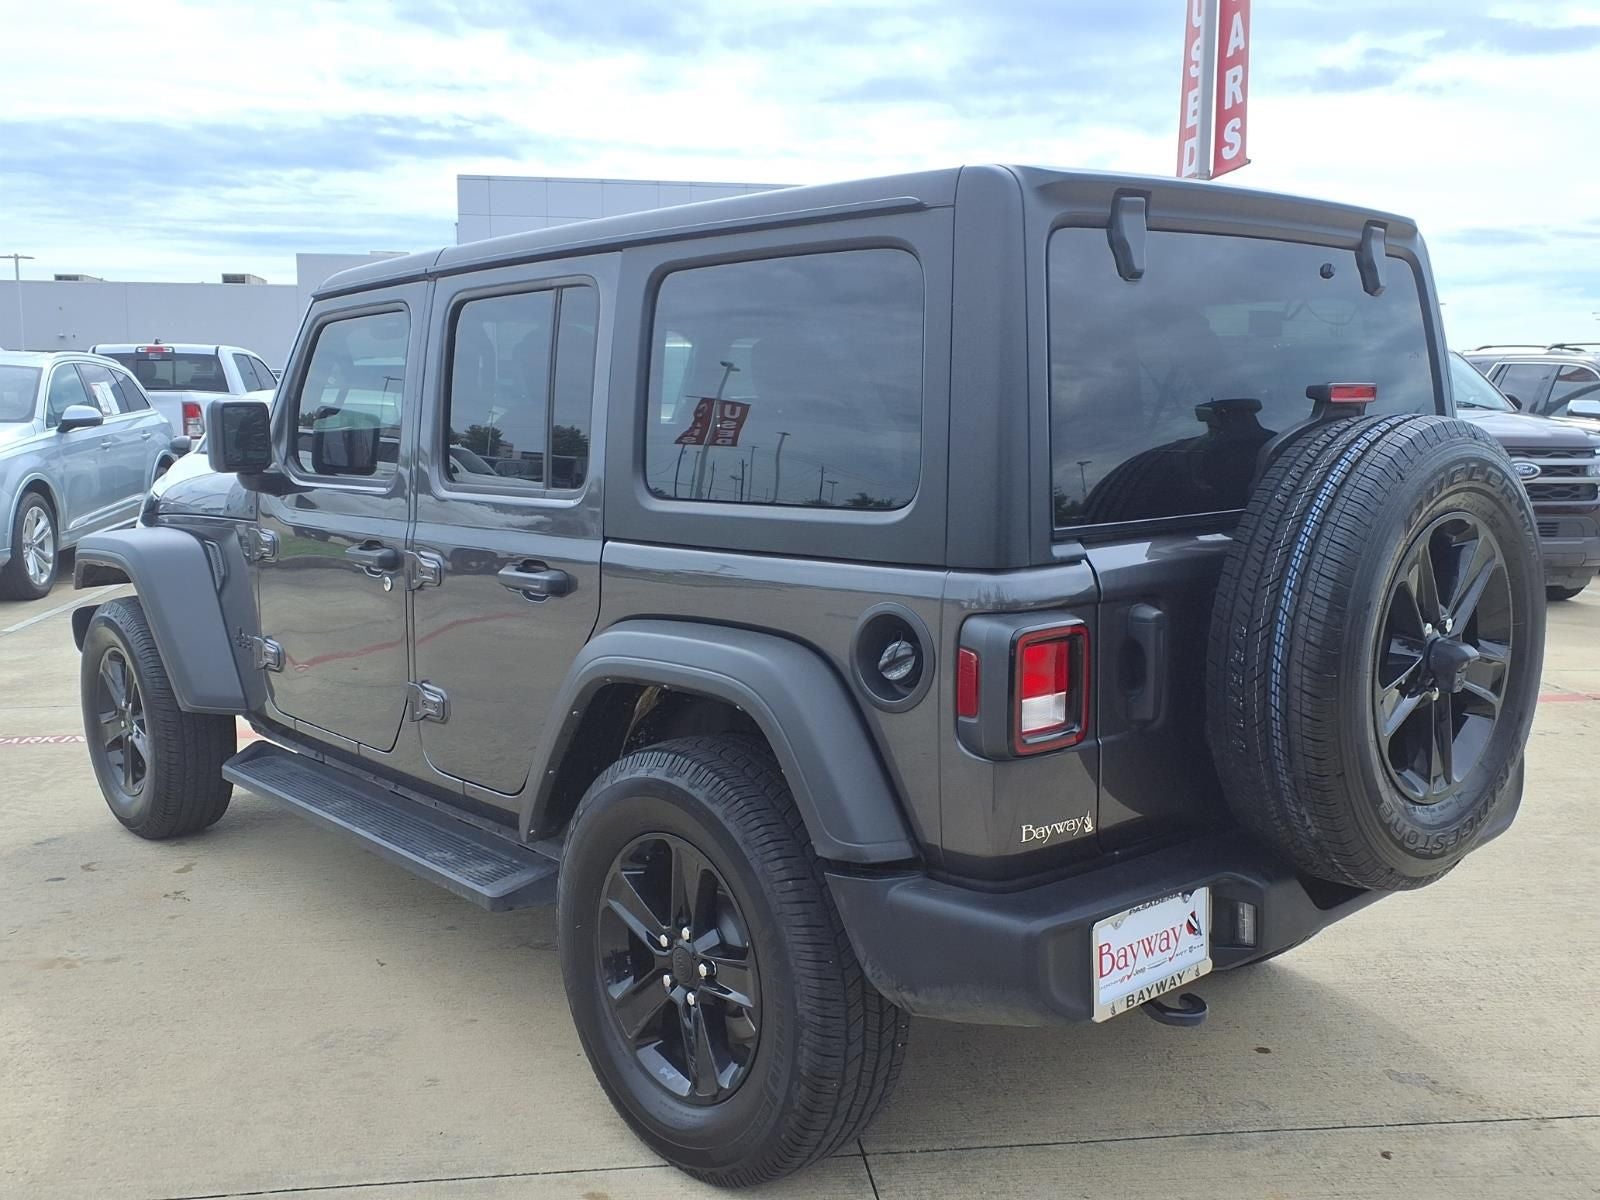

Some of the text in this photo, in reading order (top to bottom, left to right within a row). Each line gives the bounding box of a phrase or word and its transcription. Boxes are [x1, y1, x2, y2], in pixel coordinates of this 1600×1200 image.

[1221, 0, 1245, 160] ARS
[1020, 816, 1084, 844] Bayway
[1098, 924, 1183, 981] Bayway
[1126, 970, 1185, 1009] BAYWAY
